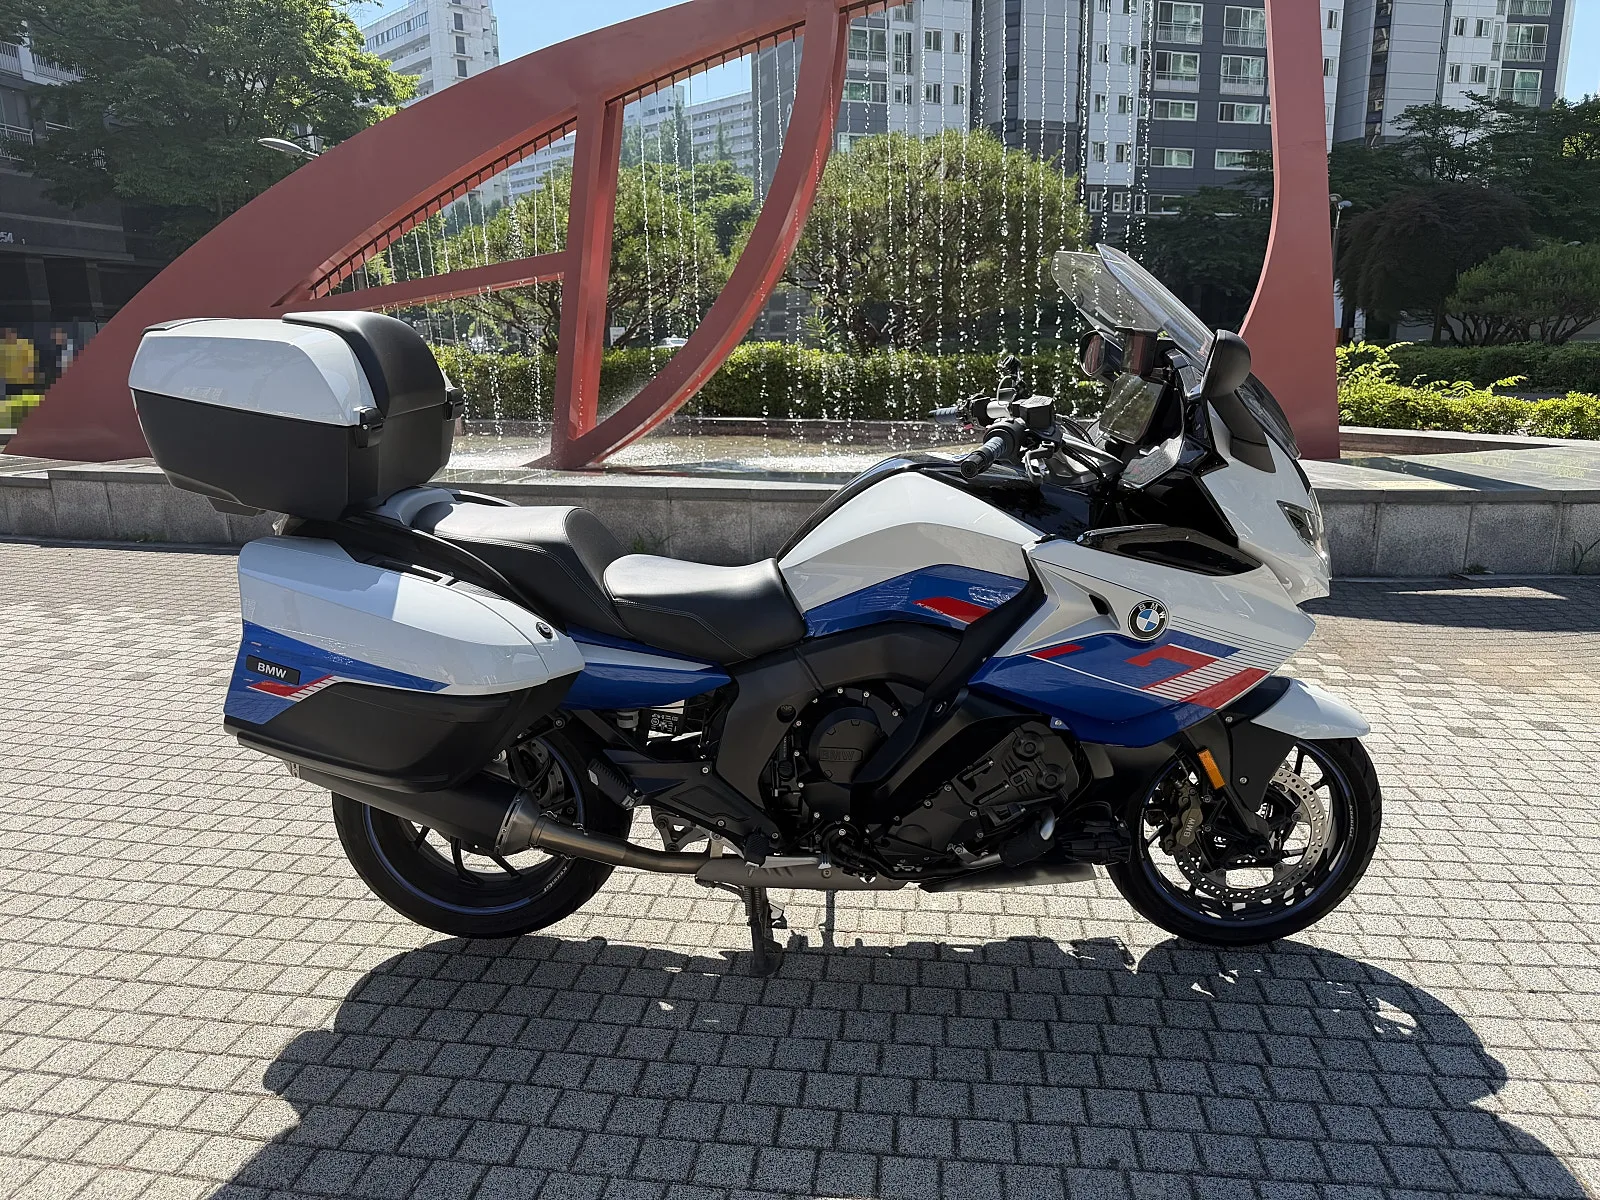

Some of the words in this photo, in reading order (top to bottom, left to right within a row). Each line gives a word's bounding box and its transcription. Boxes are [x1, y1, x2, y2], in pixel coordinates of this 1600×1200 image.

[0, 231, 14, 243] 54
[1138, 602, 1166, 619] BMW
[257, 661, 287, 679] BMW
[820, 750, 855, 761] BMW
[1183, 816, 1196, 837] BMW
